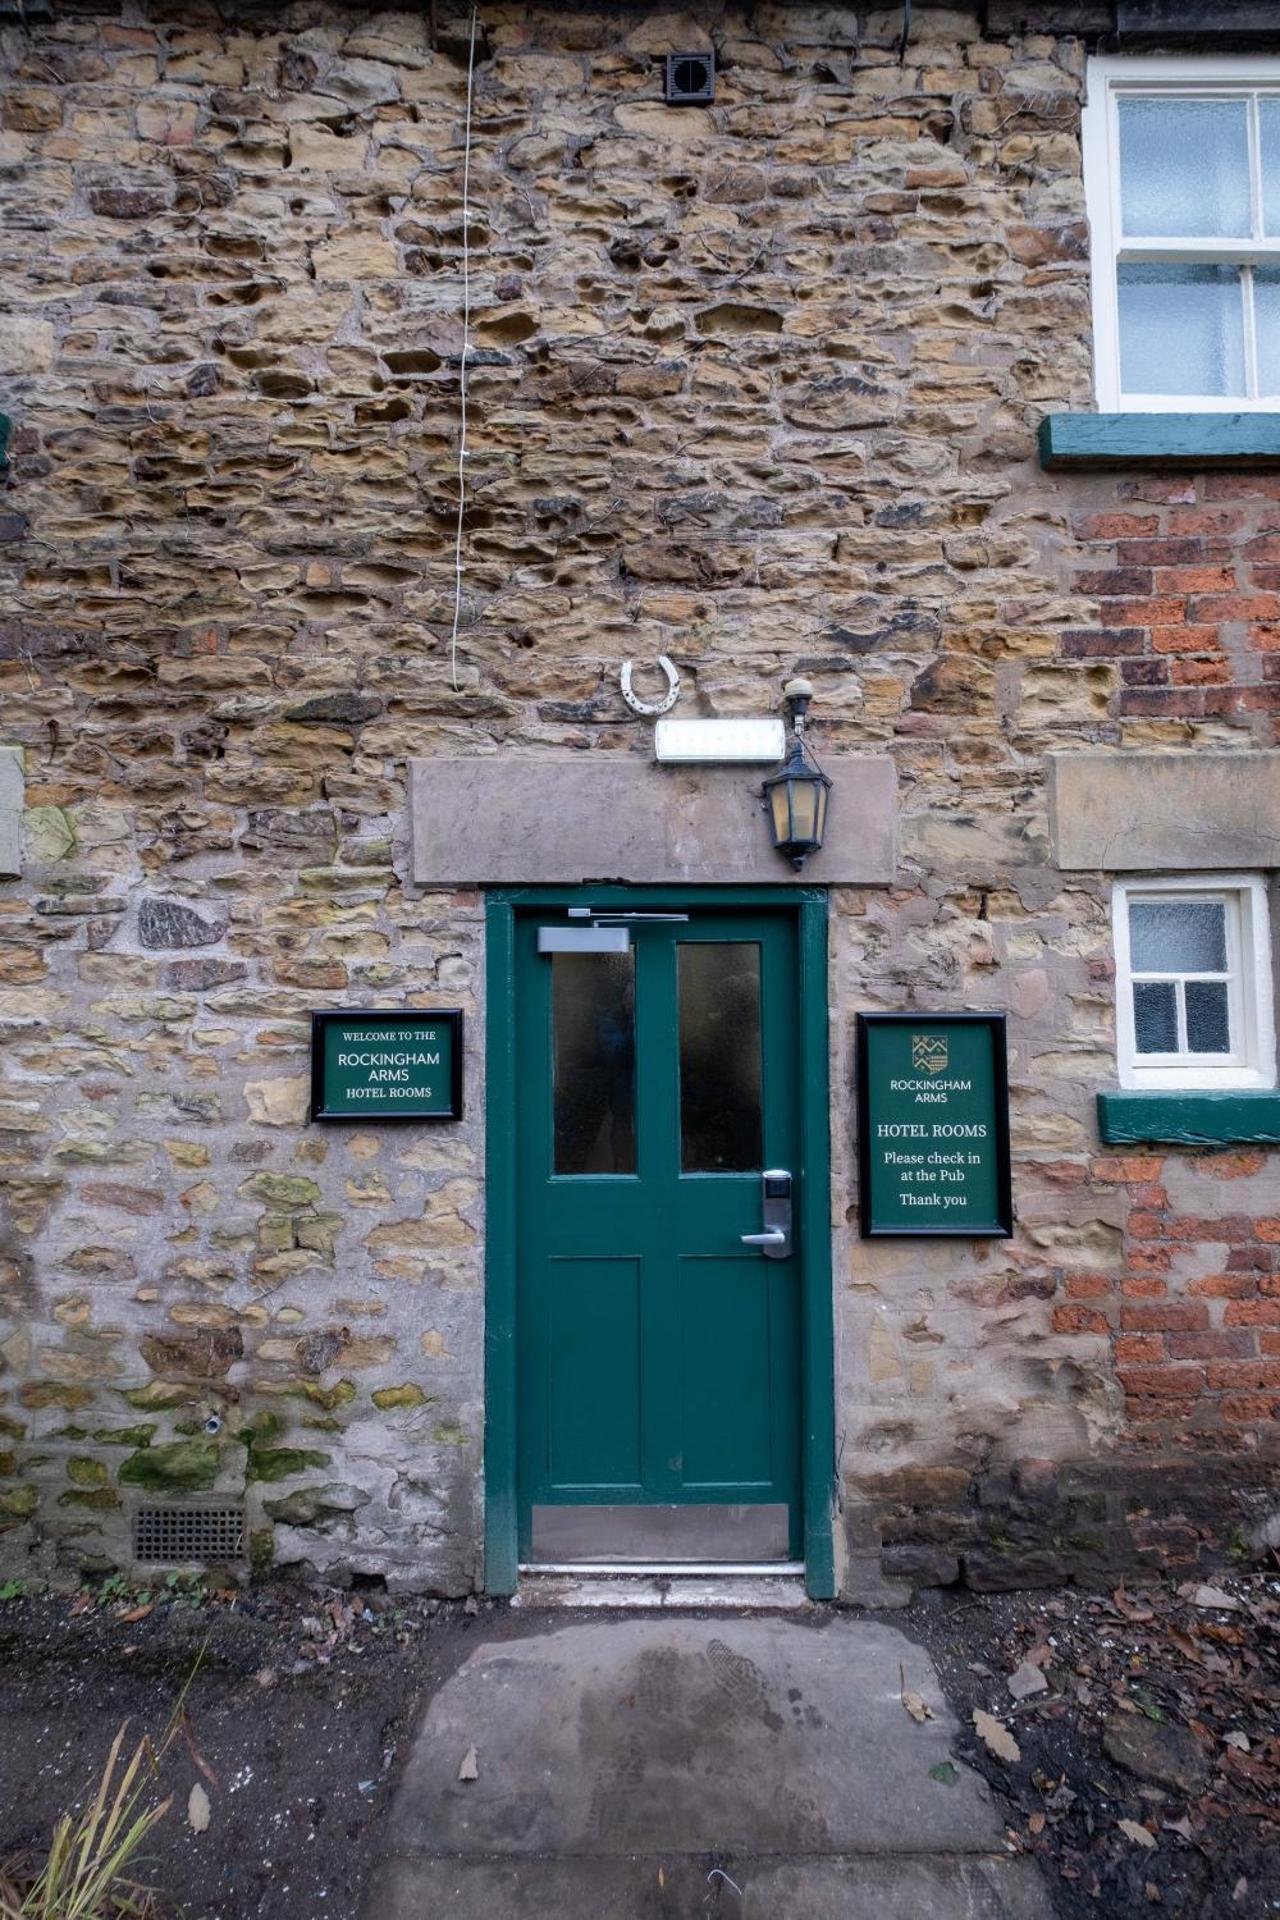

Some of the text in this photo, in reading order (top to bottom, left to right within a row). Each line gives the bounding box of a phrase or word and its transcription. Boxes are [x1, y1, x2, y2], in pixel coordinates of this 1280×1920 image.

[343, 1032, 436, 1041] WELCOME TO THE
[338, 1053, 439, 1065] ROCKINGHAM
[368, 1069, 409, 1081] ARMS
[891, 1080, 971, 1090] ROCKINGHAM
[346, 1088, 432, 1098] HOTEL ROOMS
[915, 1093, 947, 1102] ARMS
[878, 1125, 987, 1137] HOTEL ROOMS
[884, 1152, 980, 1164] Please check in
[901, 1170, 964, 1181] at the Pub
[900, 1194, 967, 1208] Thank you
